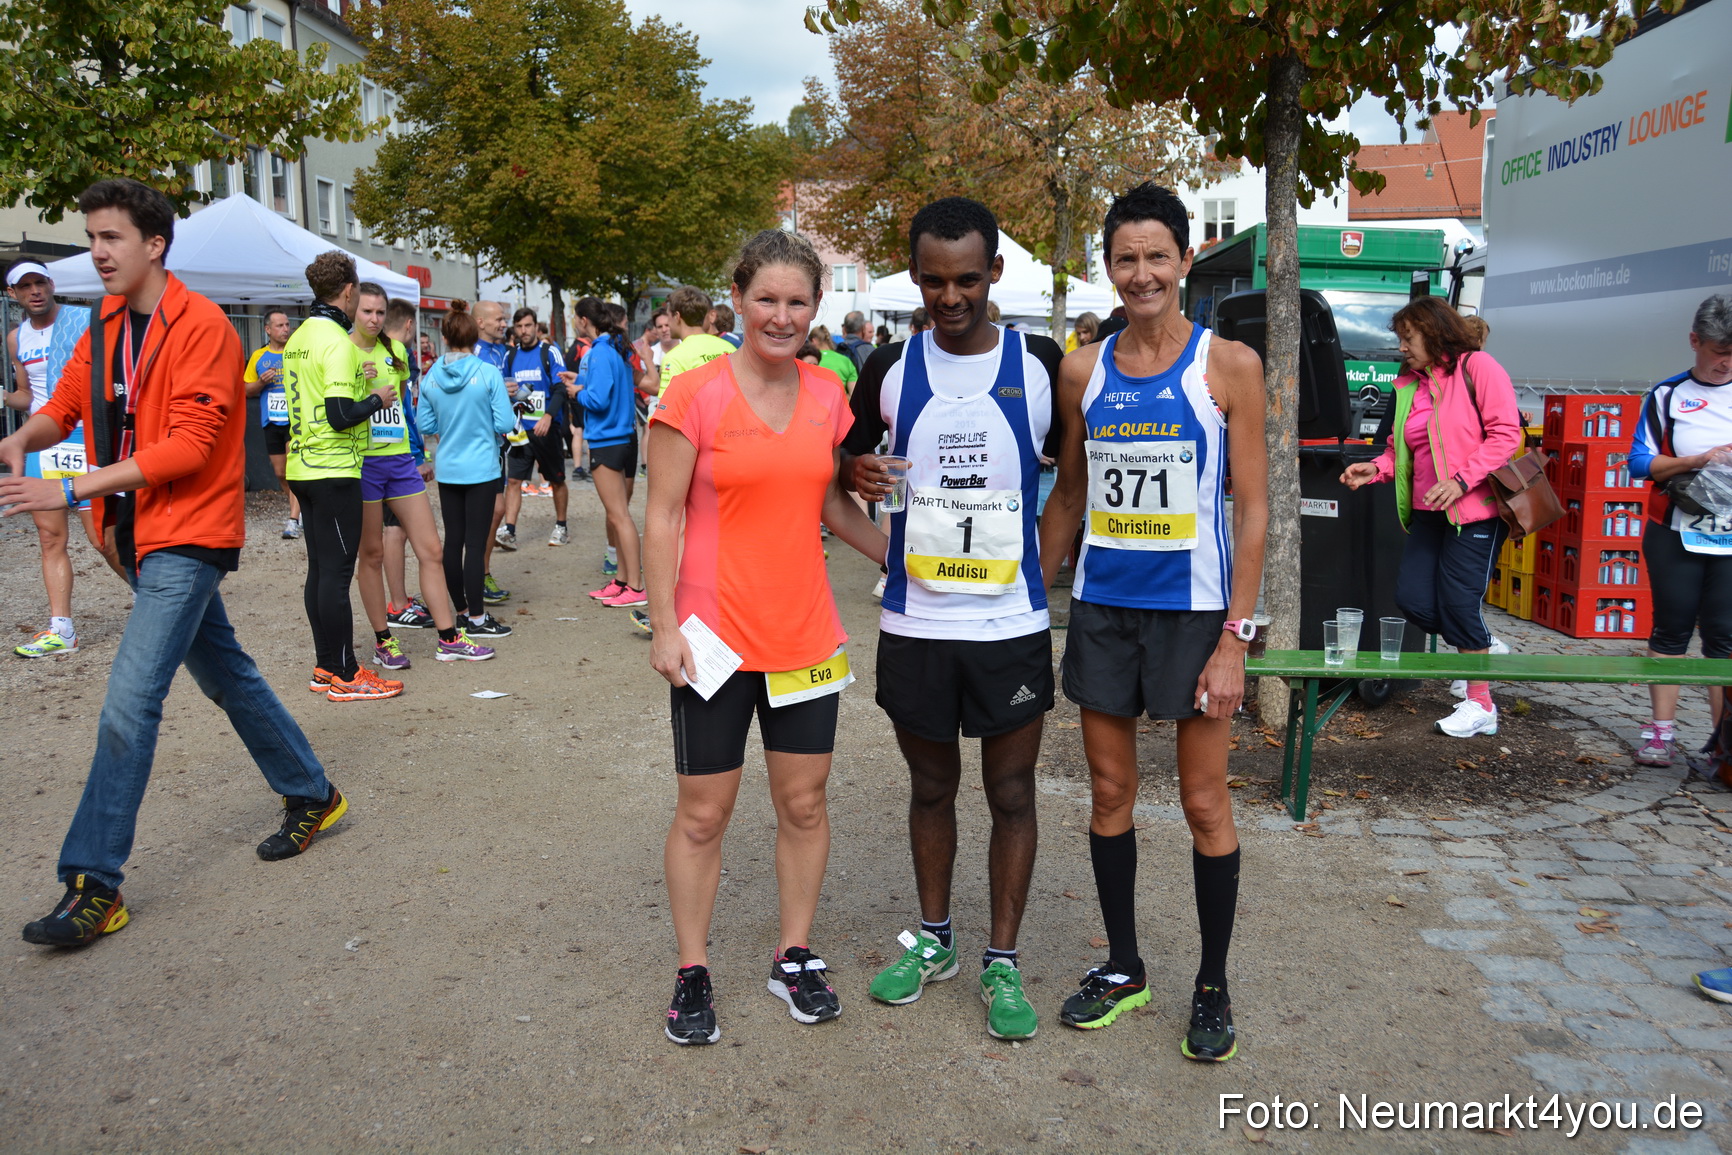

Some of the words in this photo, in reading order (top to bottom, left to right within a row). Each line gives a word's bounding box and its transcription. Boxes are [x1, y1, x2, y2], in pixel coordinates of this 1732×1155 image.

[1501, 149, 1543, 186] OFFICE
[1547, 121, 1623, 173] INDUSTRY
[1628, 89, 1708, 147] LOUNGE
[1530, 263, 1631, 296] www.bockonline.de
[1104, 392, 1141, 403] HEITEC
[371, 428, 393, 437] Carina
[938, 433, 967, 444] FINISH
[967, 431, 988, 443] LINE
[1093, 424, 1117, 439] LAC
[1118, 422, 1182, 438] QUELLE
[51, 452, 83, 470] 145
[939, 453, 988, 464] FALKE
[1089, 450, 1118, 463] PARTL
[1120, 453, 1175, 463] Neumarkt
[940, 474, 988, 488] PowerBar
[1103, 468, 1169, 508] 371
[912, 497, 949, 509] PARTL
[951, 500, 1002, 511] Neumarkt
[956, 516, 973, 553] 1
[1108, 518, 1171, 536] Christine
[936, 562, 988, 580] Addisu
[810, 667, 832, 684] Eva
[1010, 692, 1036, 706] adidas
